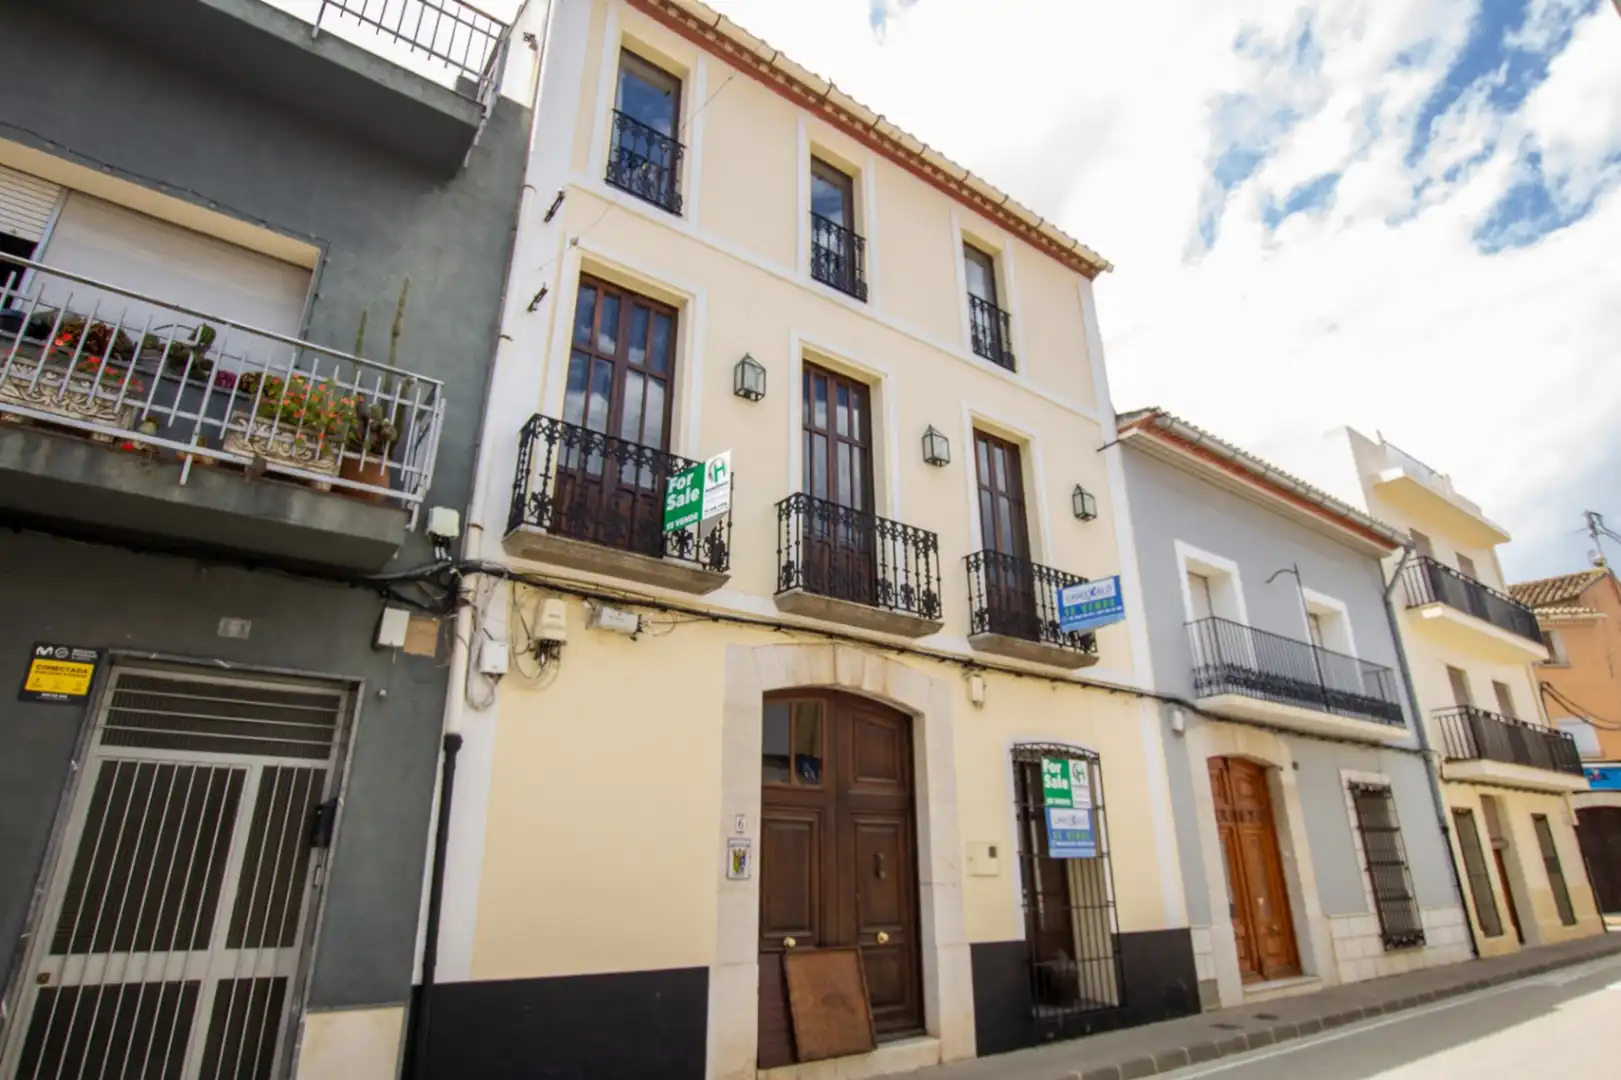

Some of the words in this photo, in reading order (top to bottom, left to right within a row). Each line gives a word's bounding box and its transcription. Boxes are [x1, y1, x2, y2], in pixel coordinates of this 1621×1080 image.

[668, 472, 694, 493] For
[666, 487, 700, 511] Sale
[36, 664, 88, 674] CONECTADA
[1042, 759, 1062, 774] For
[1043, 773, 1070, 790] Sale
